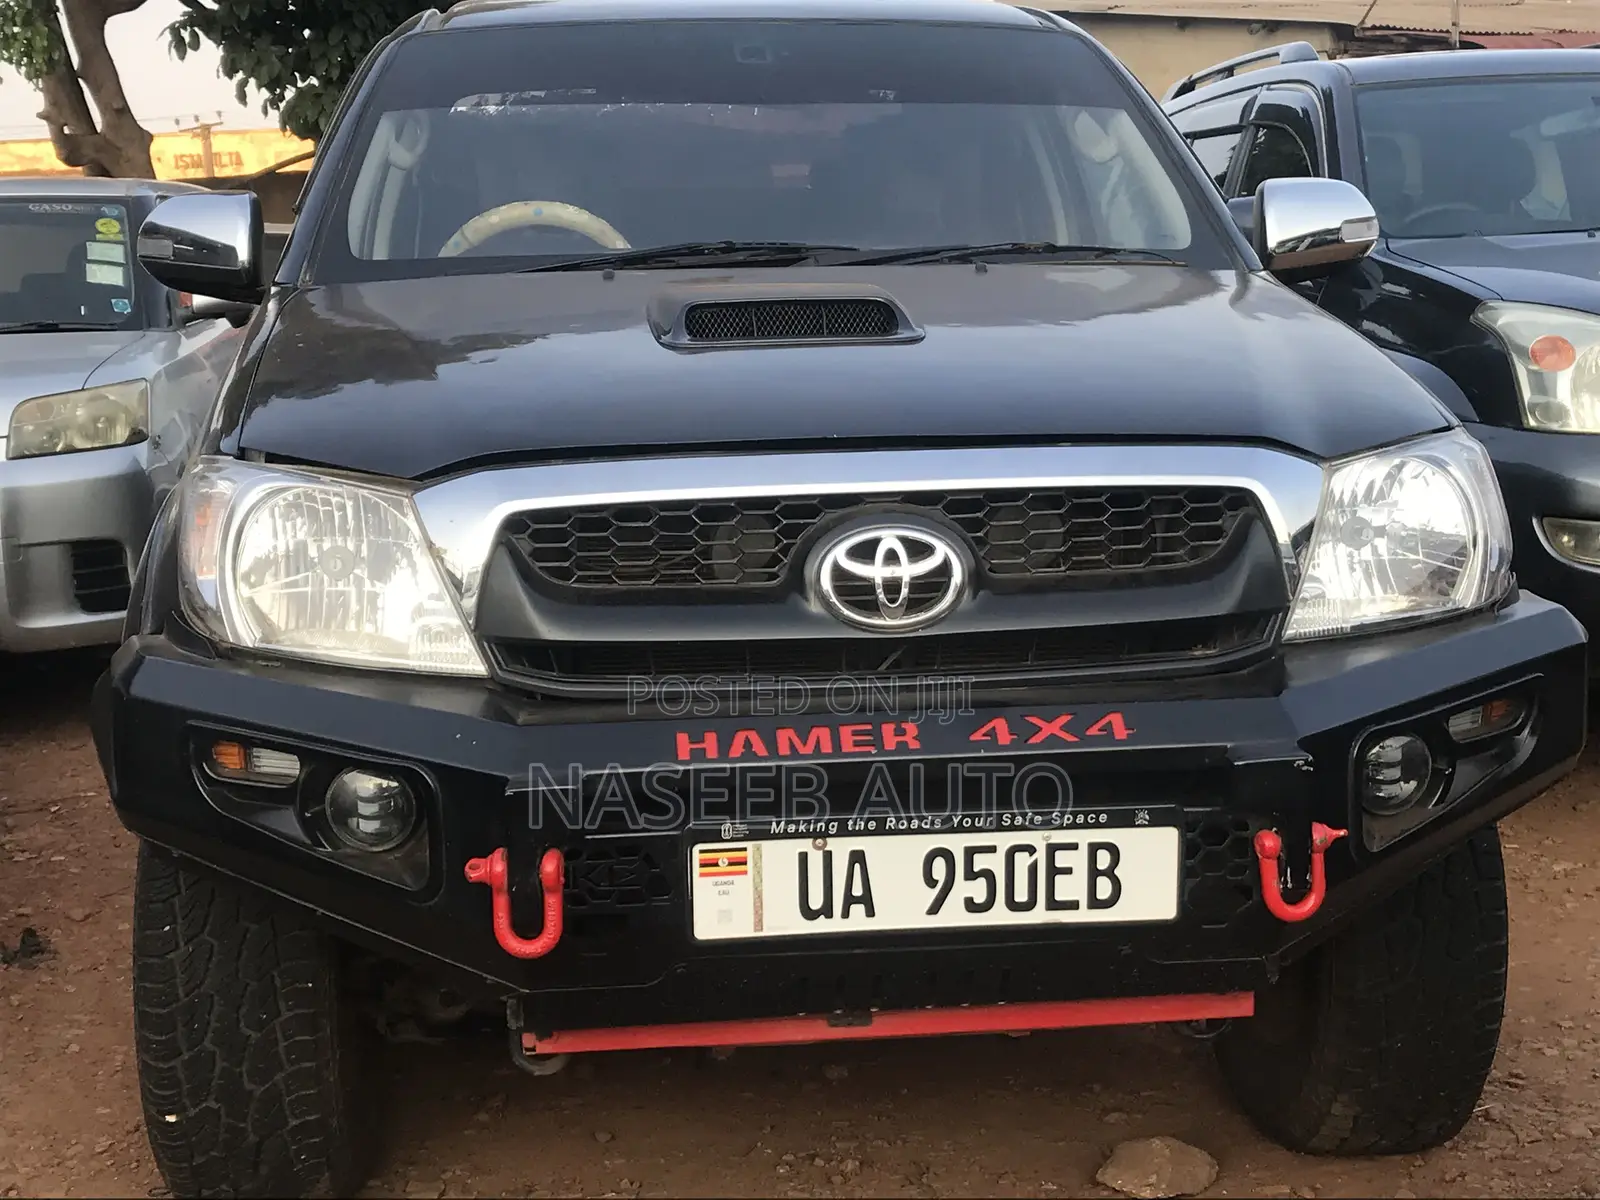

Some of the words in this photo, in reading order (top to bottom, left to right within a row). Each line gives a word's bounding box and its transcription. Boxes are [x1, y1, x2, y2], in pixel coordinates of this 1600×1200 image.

[675, 722, 921, 761] HAMER
[968, 711, 1137, 746] 4X4
[770, 820, 838, 834] Making
[847, 818, 876, 831] the
[886, 816, 942, 830] Roads
[952, 815, 993, 828] Your
[1001, 813, 1042, 826] Safe
[1051, 811, 1108, 827] Space
[798, 849, 876, 921] UA
[922, 841, 1122, 916] 950EB
